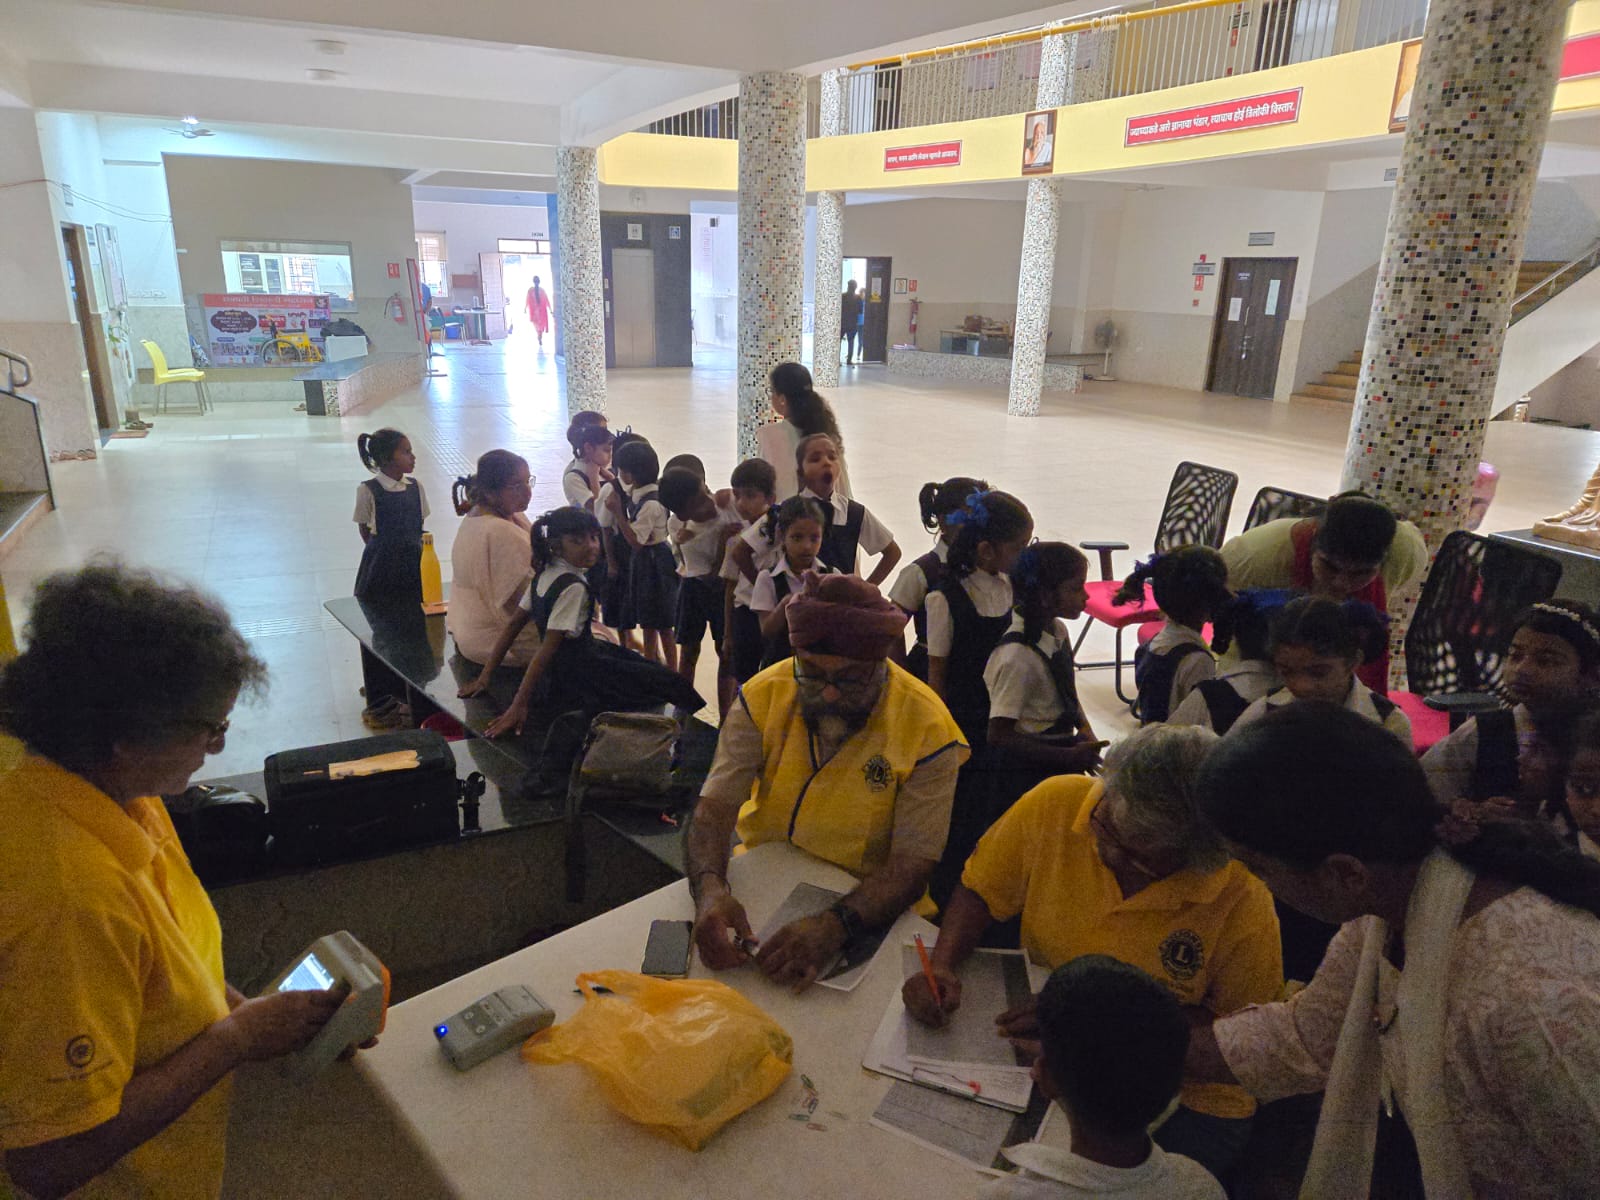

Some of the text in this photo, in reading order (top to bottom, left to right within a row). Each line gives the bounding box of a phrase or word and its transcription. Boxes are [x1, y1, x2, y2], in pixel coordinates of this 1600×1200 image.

[1159, 120, 1170, 132] असे
[1234, 106, 1246, 122] होई
[1270, 101, 1295, 115] विस्तार.
